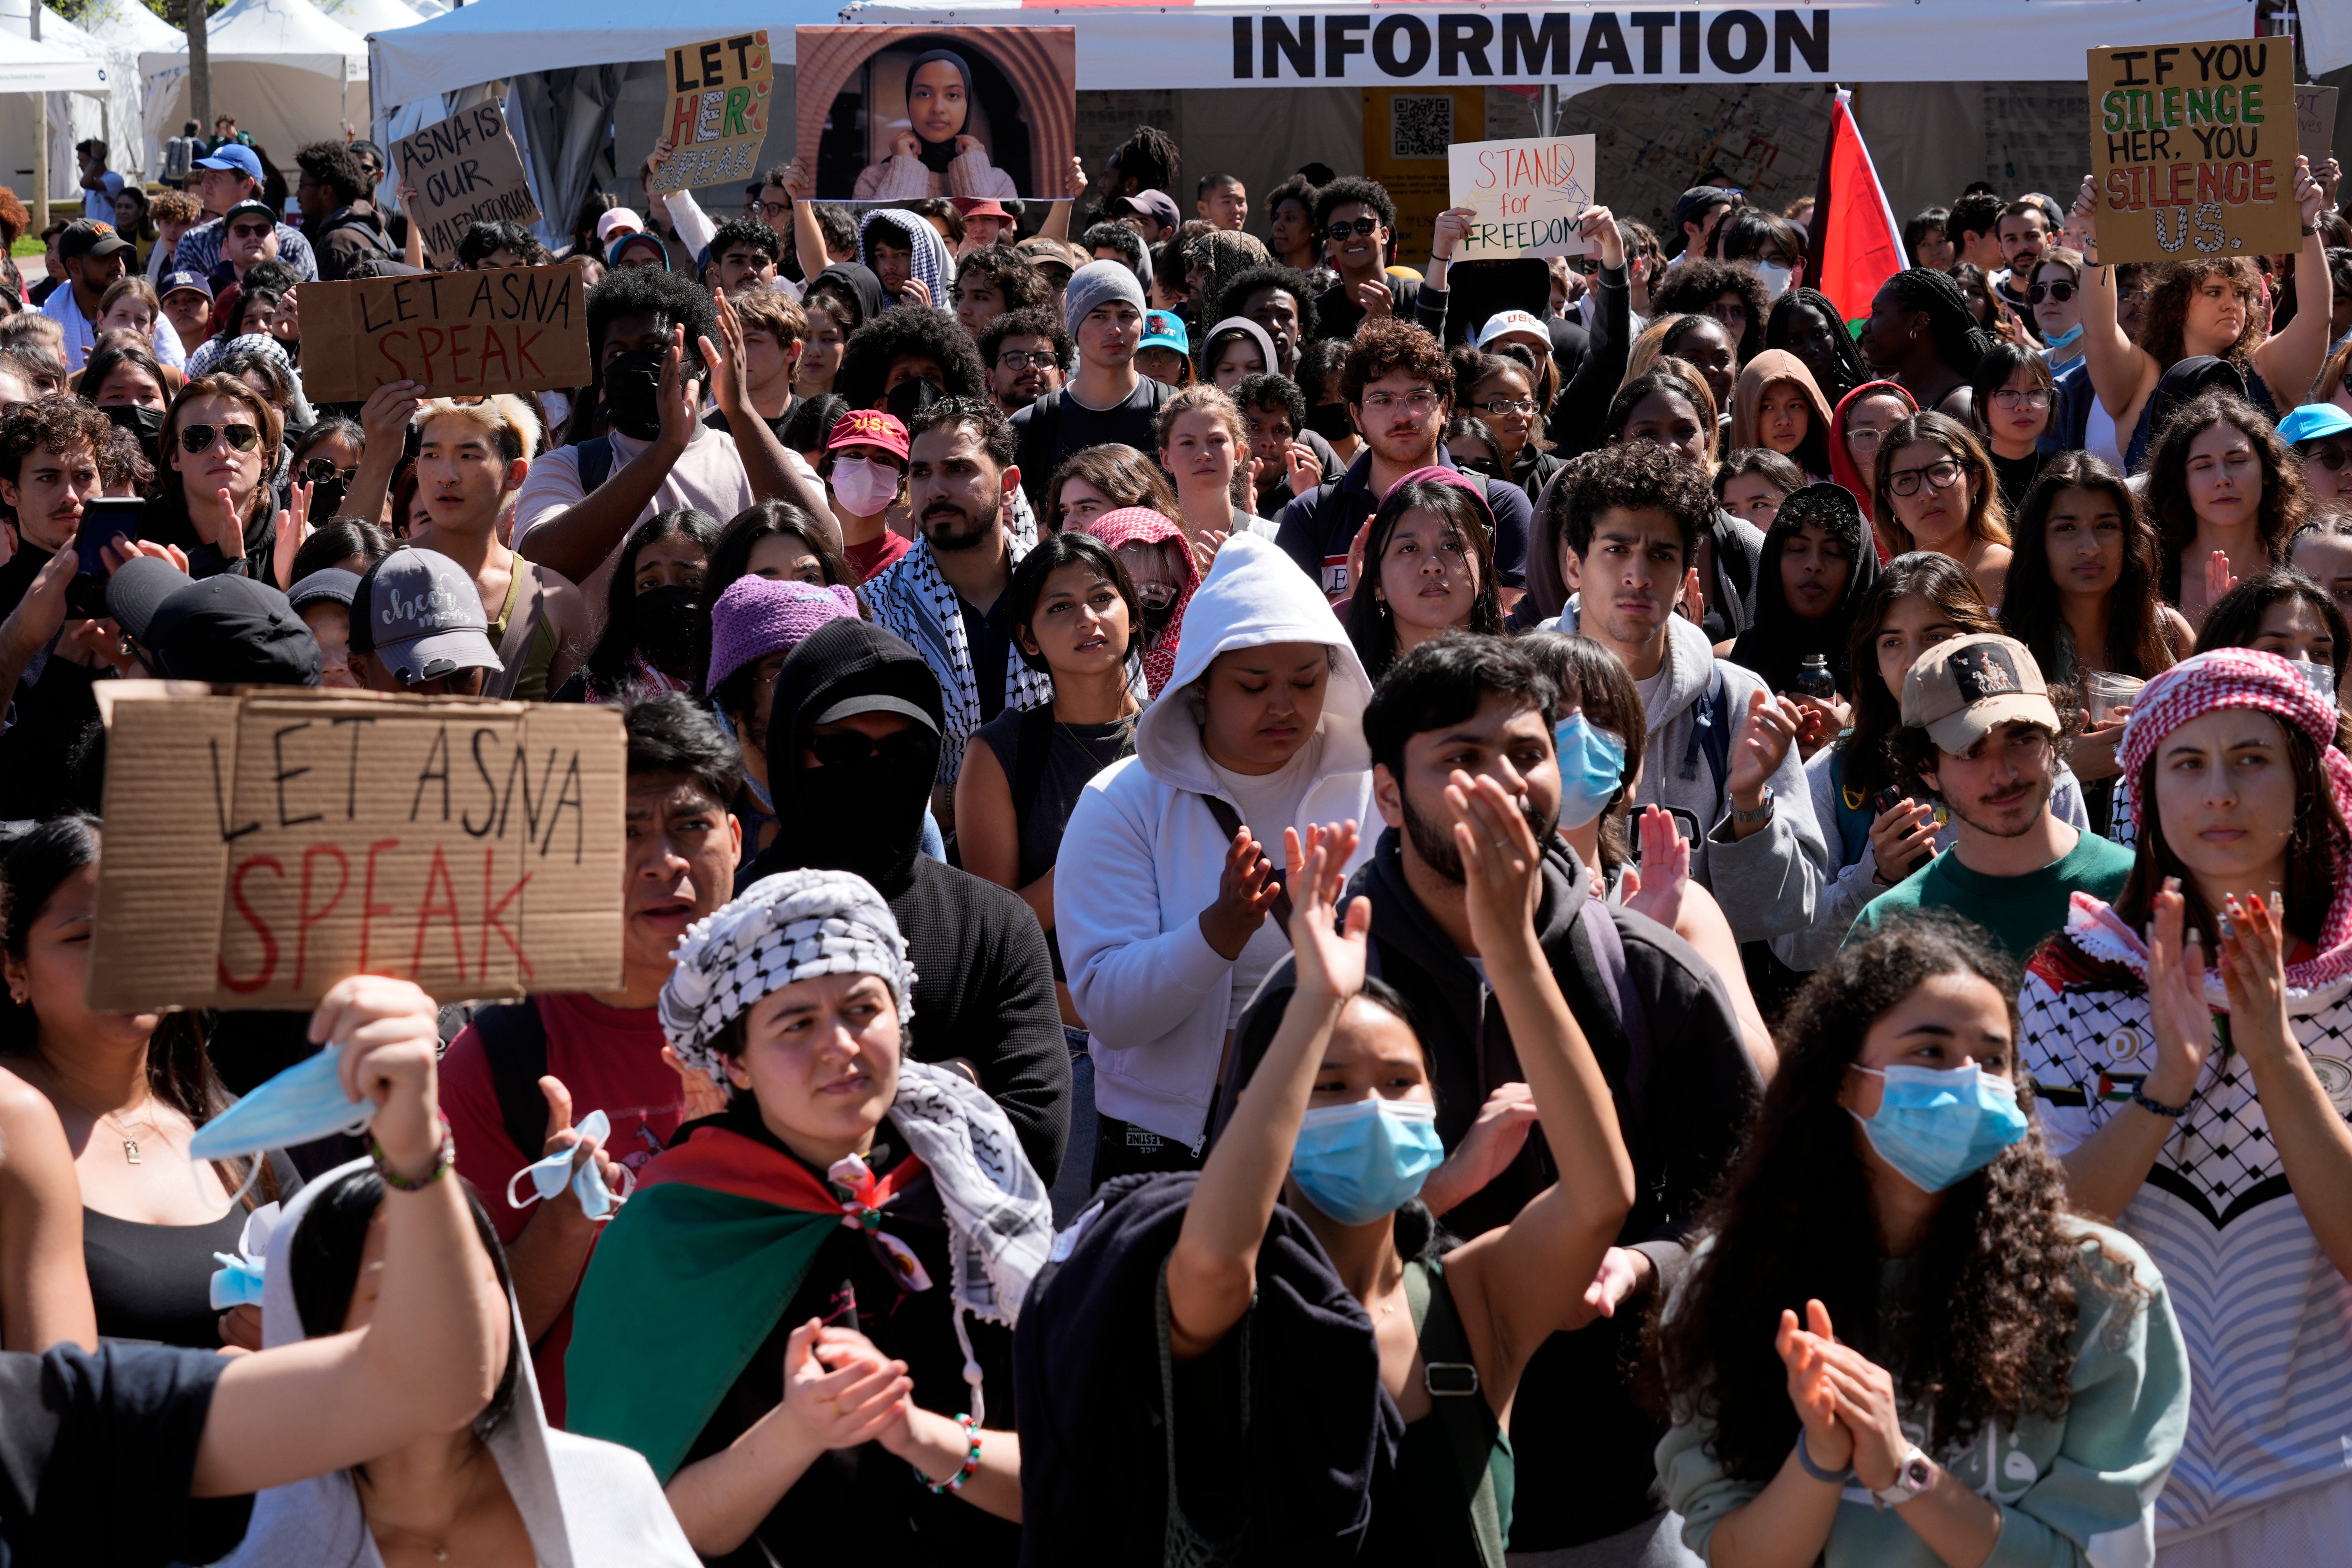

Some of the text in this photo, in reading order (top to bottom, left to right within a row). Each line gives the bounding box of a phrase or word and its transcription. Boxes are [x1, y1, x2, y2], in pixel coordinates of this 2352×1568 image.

[674, 35, 753, 93] LET
[1233, 10, 1829, 79] INFORMATION
[2111, 44, 2267, 87] IF YOU
[670, 87, 750, 147] HER
[2101, 84, 2264, 134] SILENCE
[402, 107, 501, 178] ASNA IS
[653, 142, 756, 190] SPEAK
[1476, 143, 1575, 189] STAND
[2107, 127, 2257, 163] HER, YOU
[426, 160, 493, 207] OUR
[1499, 193, 1531, 217] for
[2105, 160, 2277, 212] SILENCE
[1464, 211, 1585, 251] FREEDOM
[2156, 203, 2242, 253] US.
[359, 273, 570, 333] LET ASNA
[1507, 314, 1536, 326] USC
[375, 325, 546, 387] SPEAK
[855, 417, 894, 435] USC
[210, 717, 584, 865] LET ASNA
[217, 838, 535, 994] SPEAK
